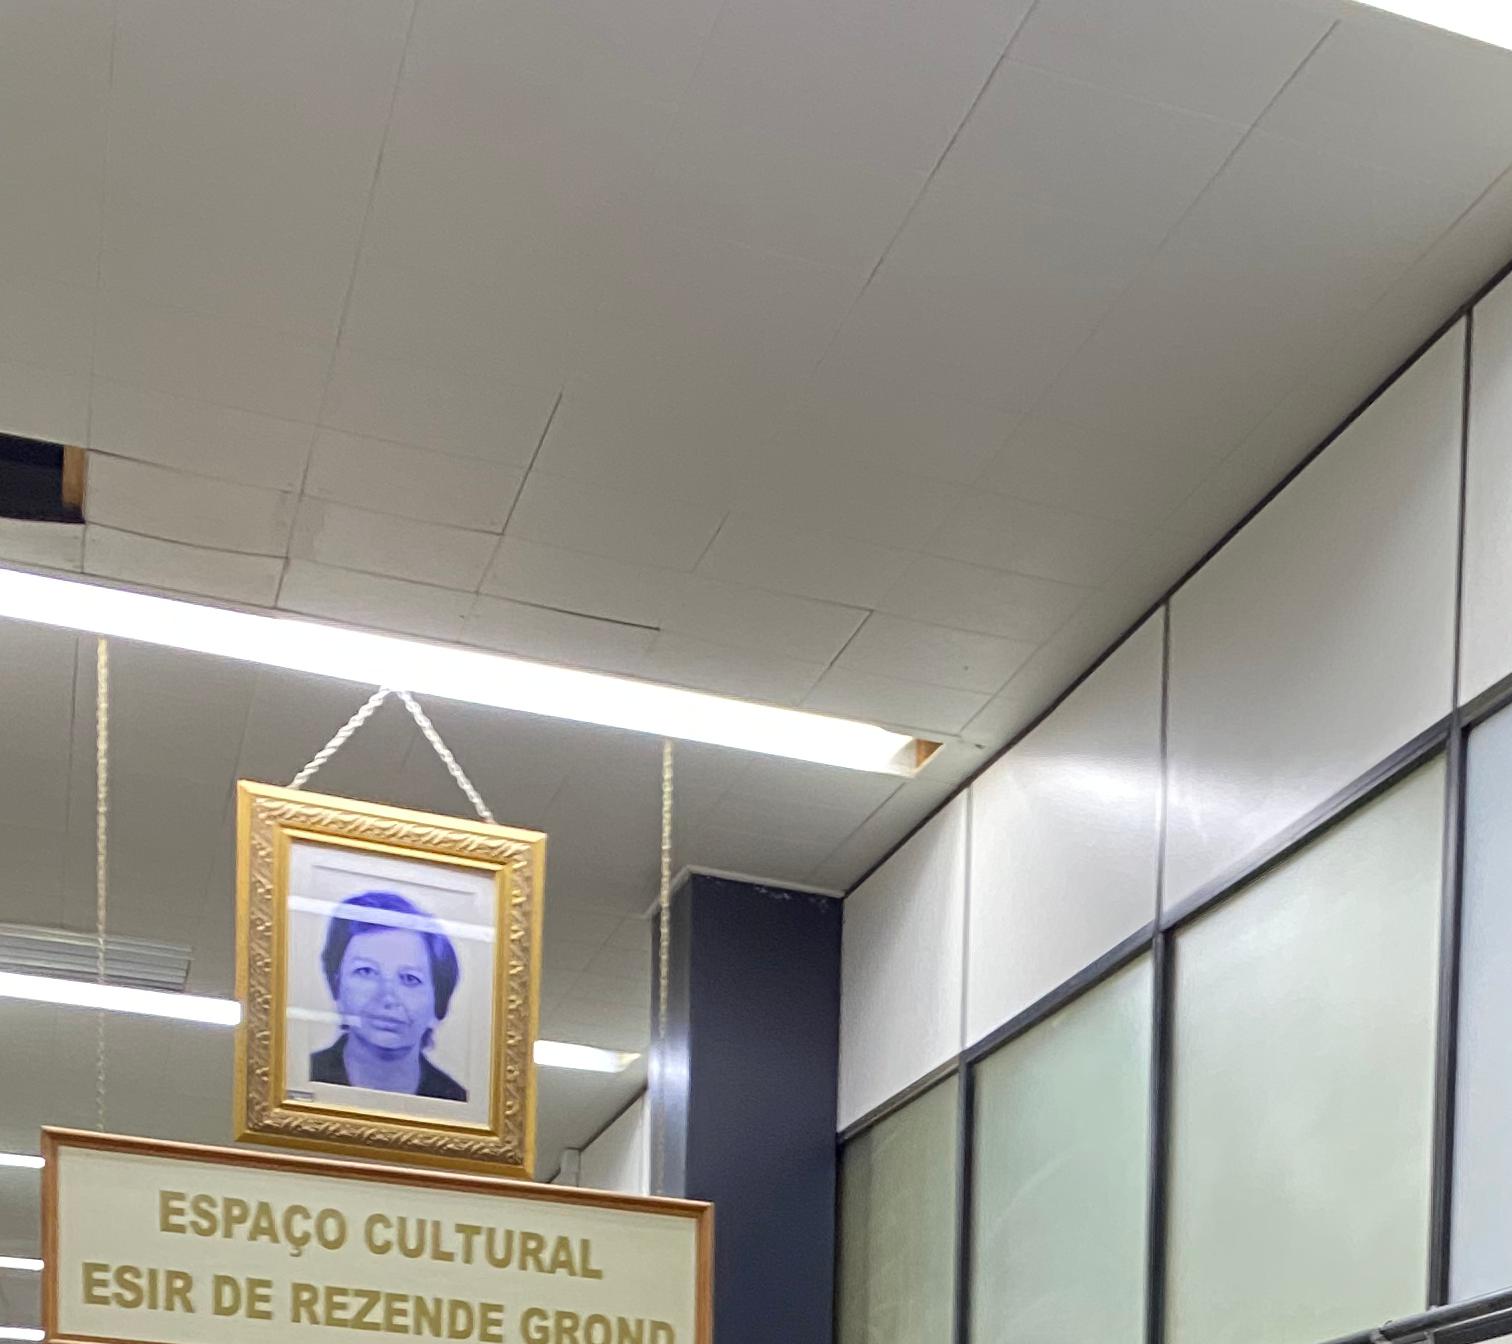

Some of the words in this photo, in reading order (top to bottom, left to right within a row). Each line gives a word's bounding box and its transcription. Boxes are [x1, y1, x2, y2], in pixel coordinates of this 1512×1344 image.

[159, 1190, 347, 1257] ESPAÇO
[364, 1213, 604, 1280] CULTURAL
[82, 1262, 194, 1313] ESIR
[213, 1274, 273, 1320] DE
[291, 1283, 504, 1343] REZENDE
